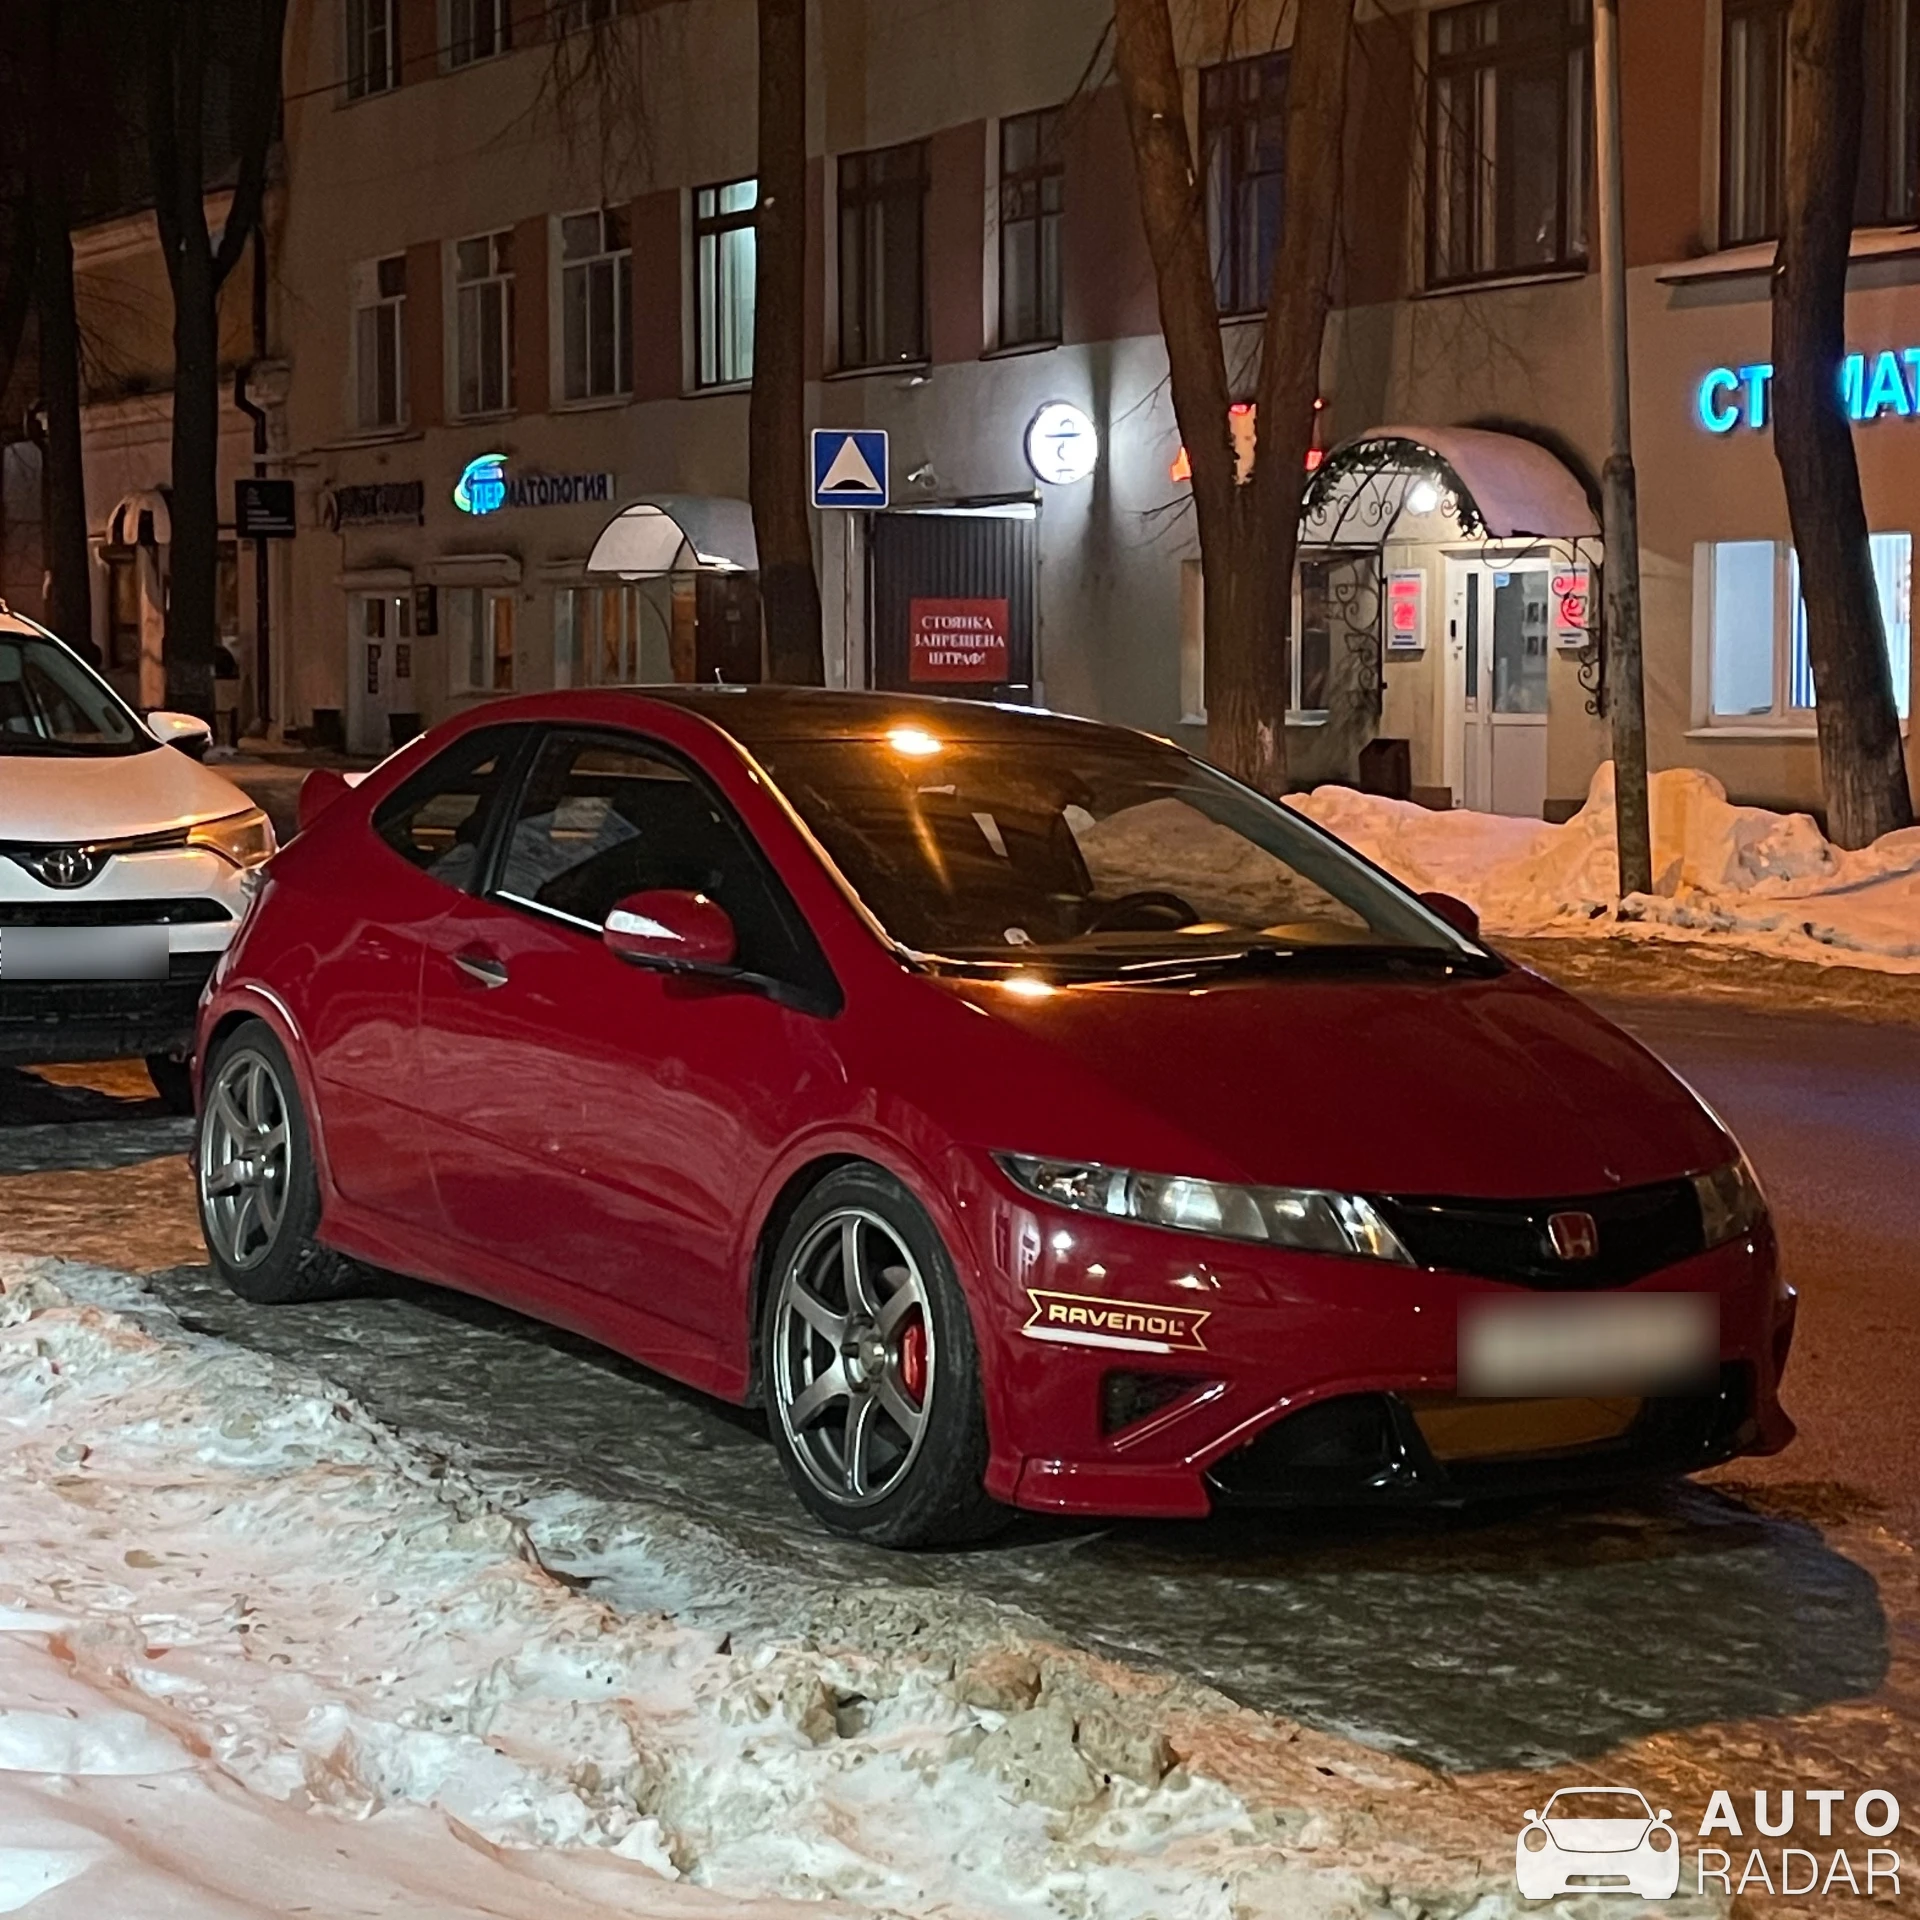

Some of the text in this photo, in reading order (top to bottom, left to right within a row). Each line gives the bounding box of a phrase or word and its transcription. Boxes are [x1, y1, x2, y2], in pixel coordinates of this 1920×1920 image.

[1700, 347, 1920, 432] СТМА
[921, 615, 993, 630] СТОЯНКА
[914, 633, 1005, 649] ЗАПРЕЩЕНА
[928, 651, 986, 667] ШТРАФ!
